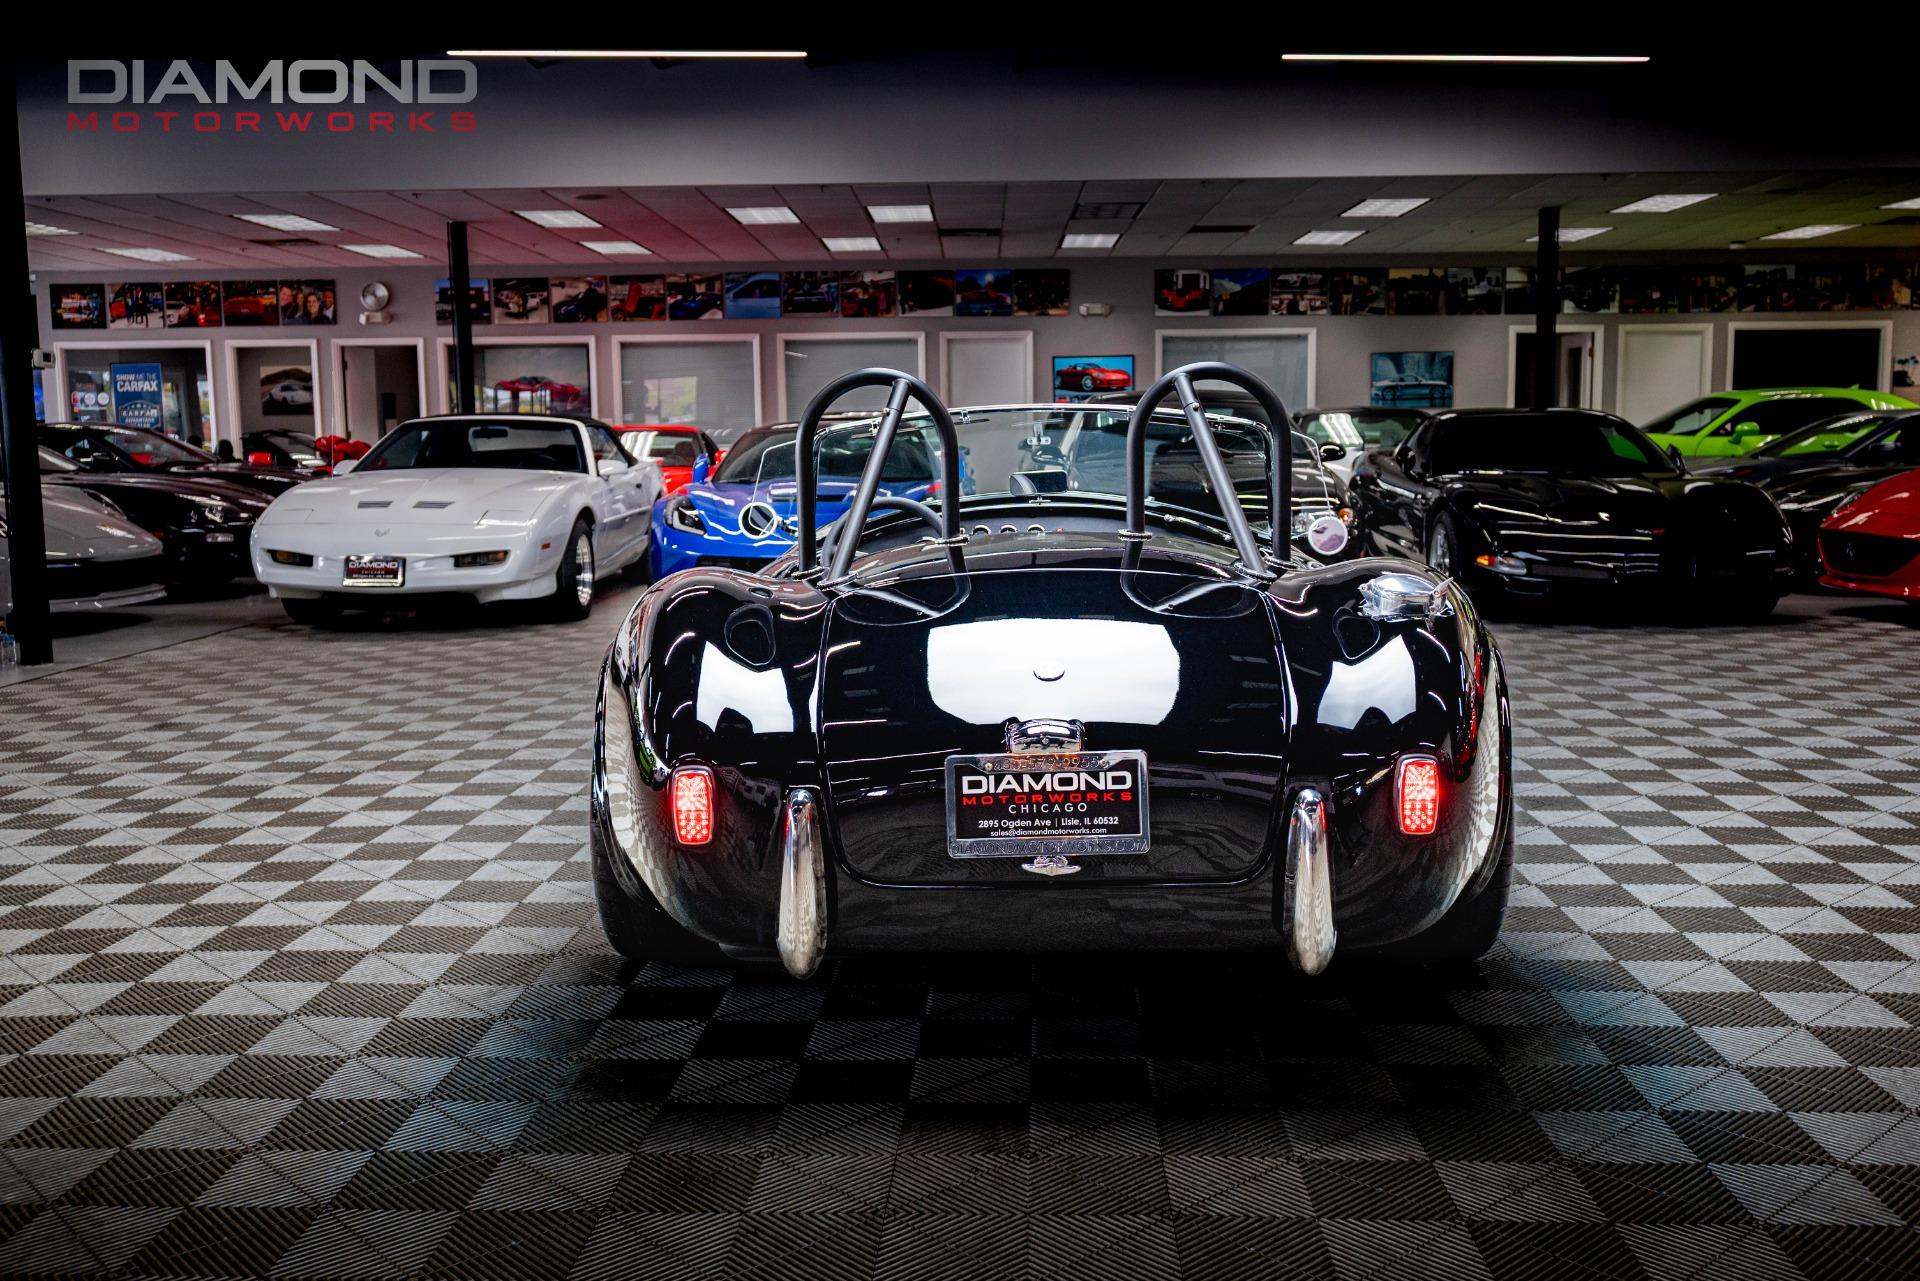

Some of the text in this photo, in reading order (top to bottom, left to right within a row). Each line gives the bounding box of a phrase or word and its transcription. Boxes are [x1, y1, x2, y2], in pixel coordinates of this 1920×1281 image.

[116, 373, 135, 381] SHOW
[117, 381, 158, 392] CARFAX
[962, 771, 1132, 795] DIAMOND
[962, 792, 1132, 806] MOTORWORKS
[1008, 802, 1088, 814] CHICAGO
[978, 819, 999, 829] 2895
[1000, 818, 1032, 830] Ogden
[1033, 818, 1052, 828] Ave
[1061, 817, 1082, 827] Lisle,
[1084, 817, 1092, 826] IL
[1093, 816, 1119, 825] 60532
[990, 826, 1107, 837] sales@diamondmotorworks.com
[950, 838, 1148, 855] DIAMONDMOTORWORKS.COM
